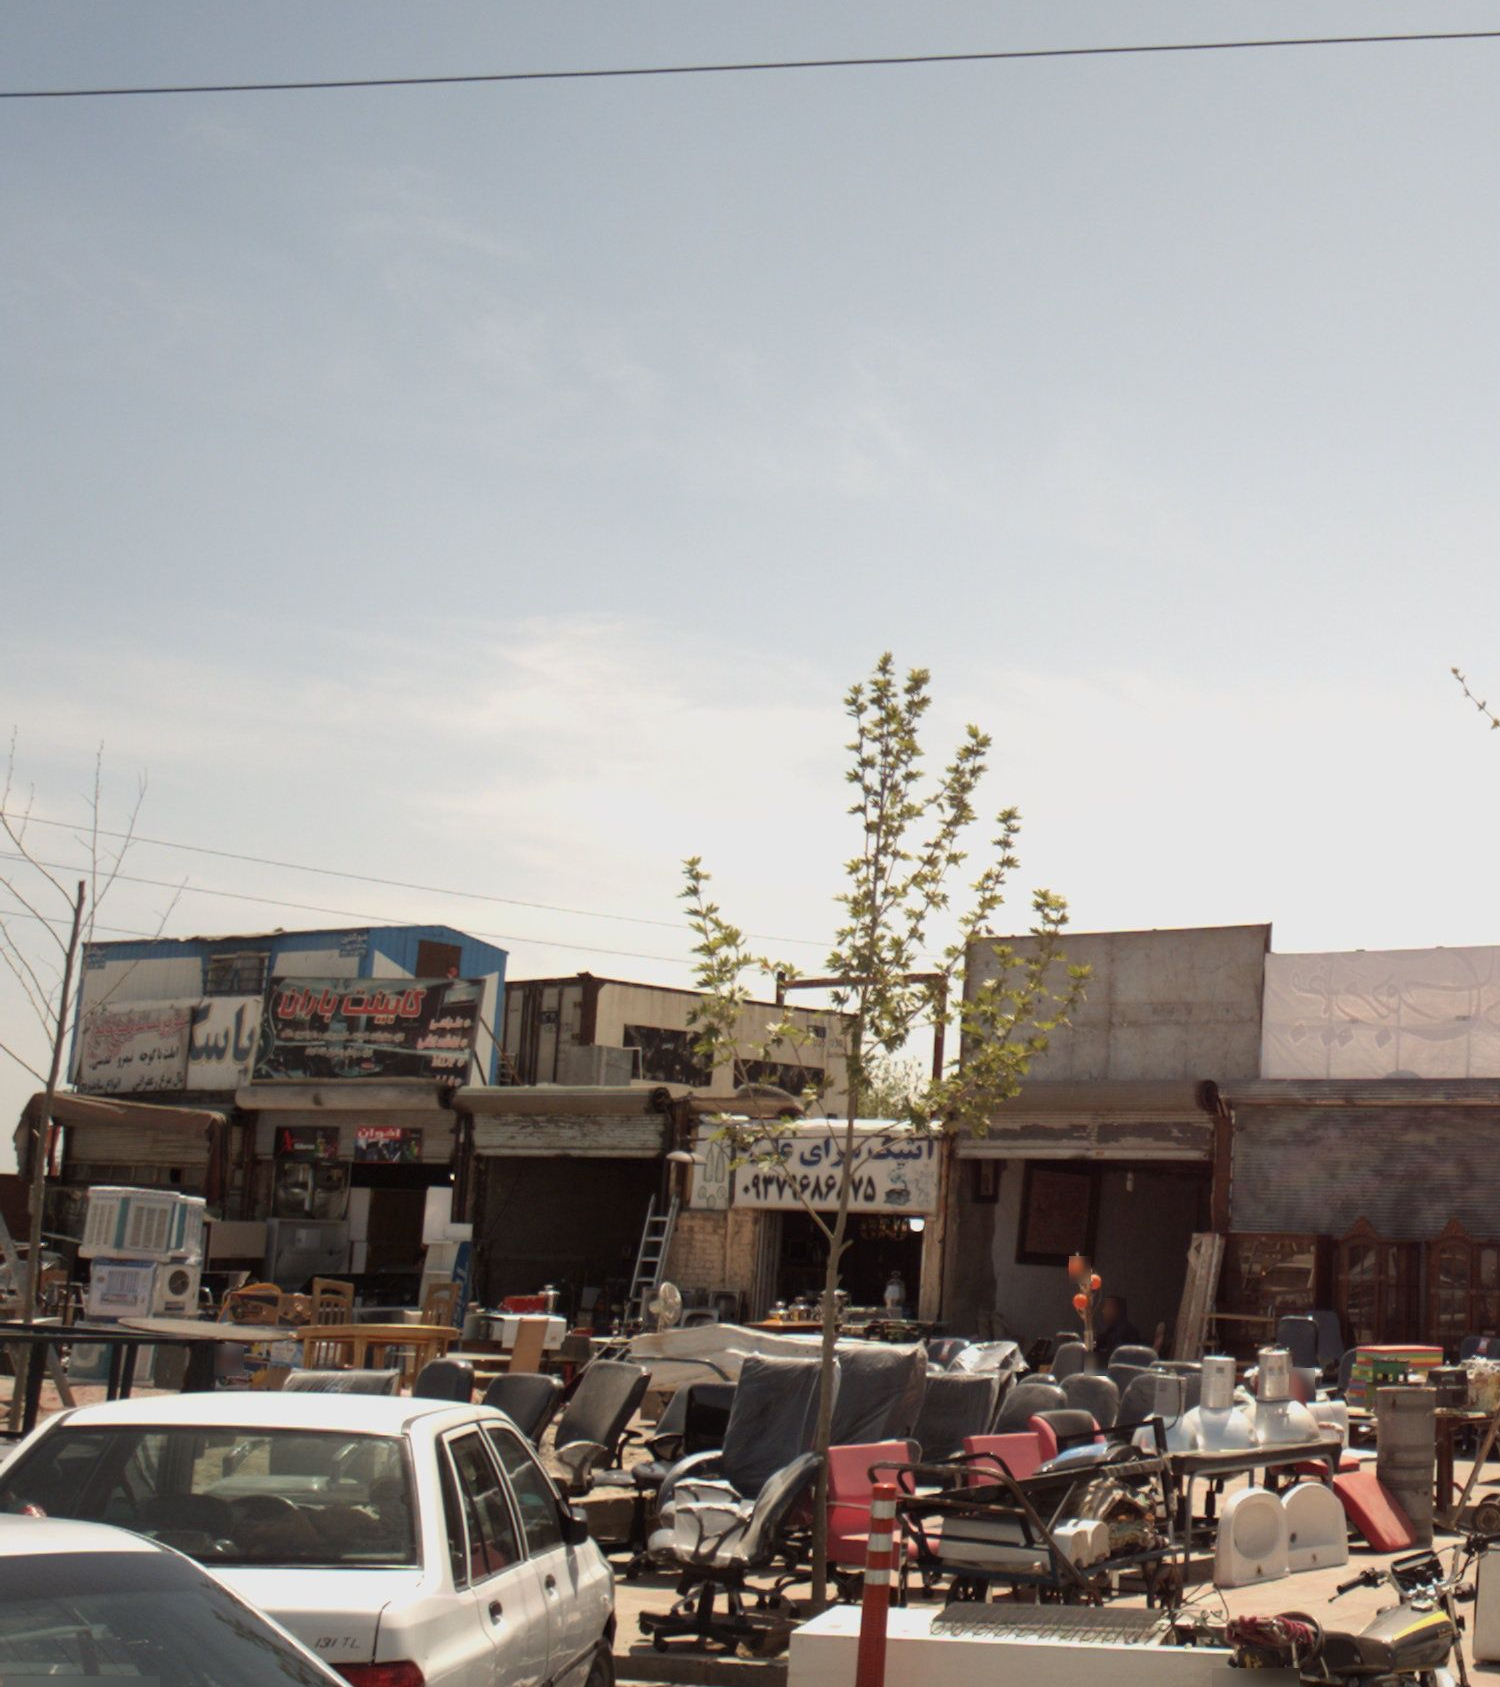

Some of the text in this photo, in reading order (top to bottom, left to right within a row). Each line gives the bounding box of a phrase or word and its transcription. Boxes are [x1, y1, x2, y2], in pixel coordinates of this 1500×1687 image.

[278, 987, 339, 1022] باران
[341, 987, 427, 1024] کابینت
[743, 1172, 877, 1203] ۰۹۳۷۹۶۸۶۷۵
[343, 1636, 361, 1649] TL
